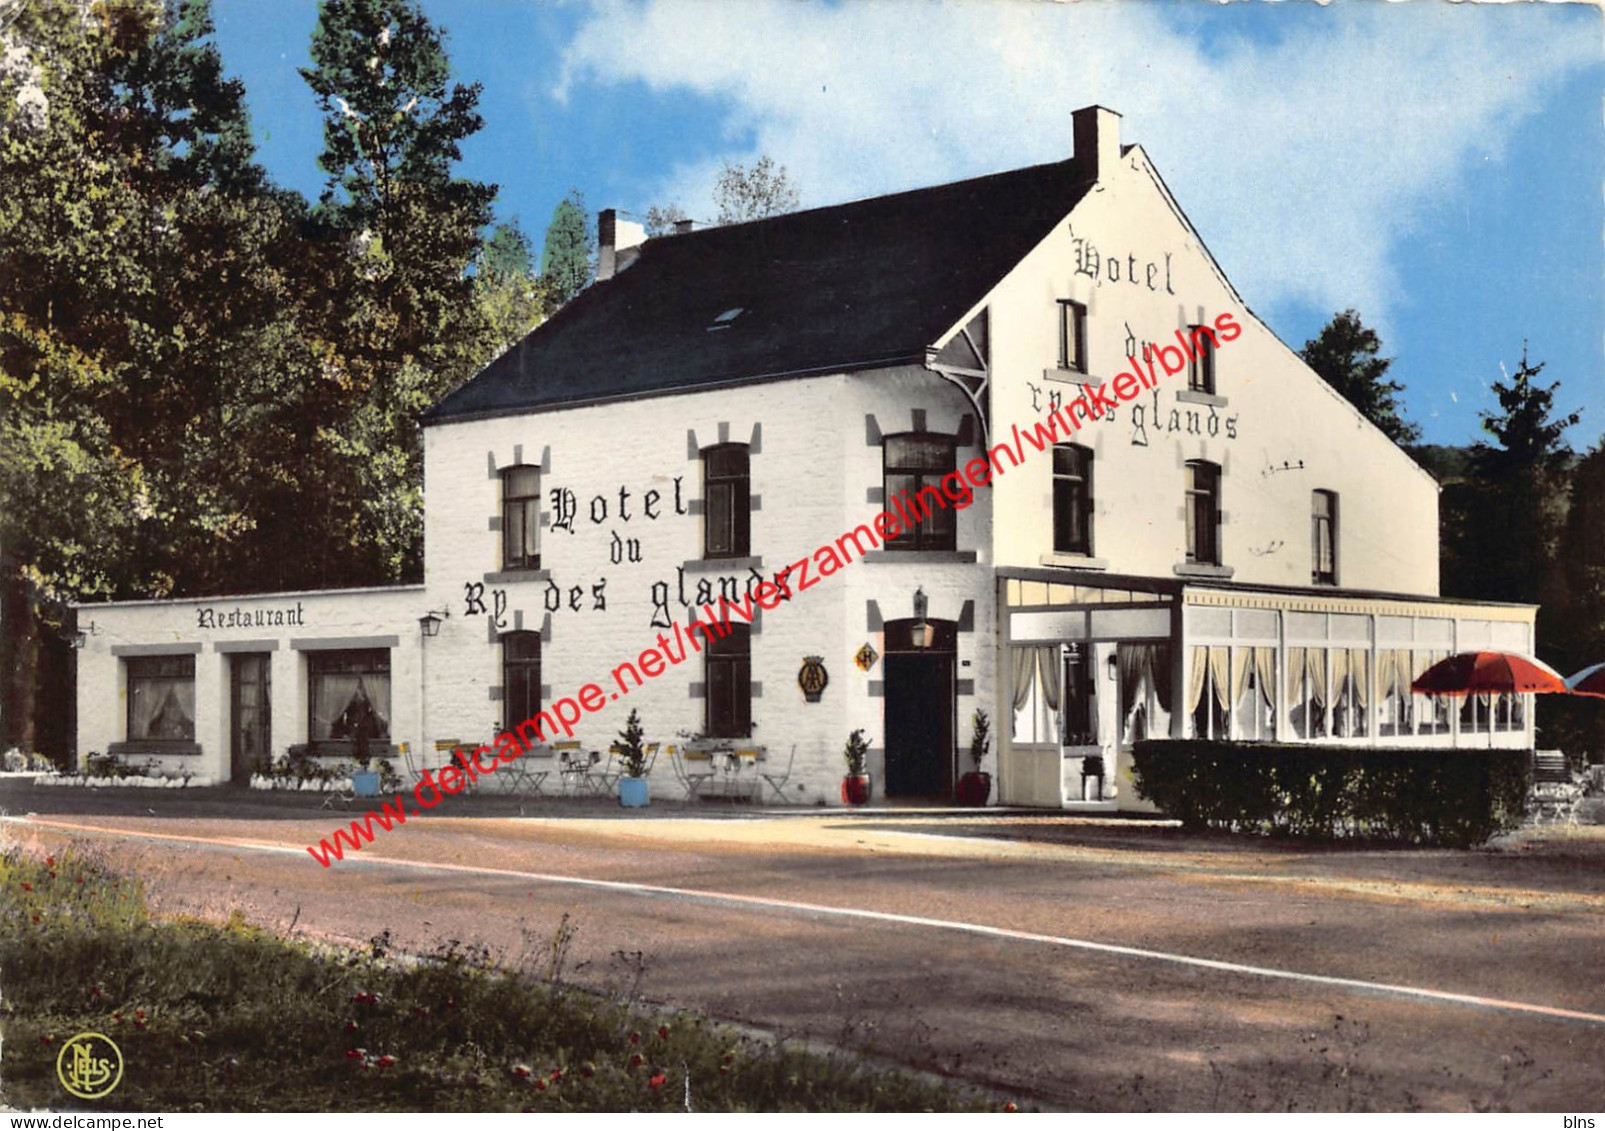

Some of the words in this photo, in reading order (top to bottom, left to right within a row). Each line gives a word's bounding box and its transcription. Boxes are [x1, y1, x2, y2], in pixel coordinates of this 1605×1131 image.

[1069, 224, 1175, 295] Hotel
[1125, 321, 1154, 364] du
[1131, 388, 1239, 447] glands
[550, 476, 688, 535] Hotel
[610, 530, 643, 564] du
[196, 602, 305, 629] Restaurant
[464, 581, 507, 628] Ry
[544, 577, 607, 613] des
[650, 565, 792, 629] glands
